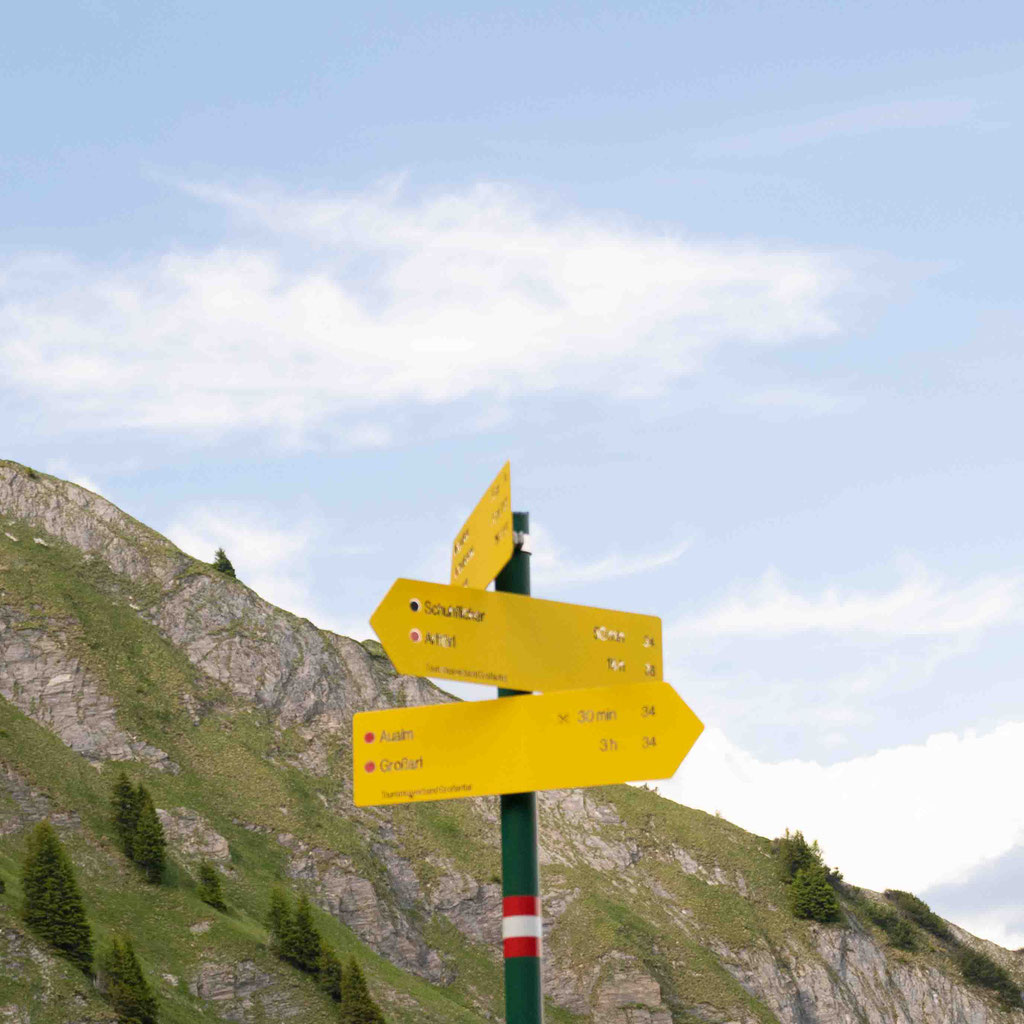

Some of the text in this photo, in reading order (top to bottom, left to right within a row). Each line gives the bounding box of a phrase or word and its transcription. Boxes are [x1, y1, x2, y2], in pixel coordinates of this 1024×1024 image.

[596, 708, 618, 722] min
[642, 705, 656, 718] 34
[643, 736, 656, 749] 34
